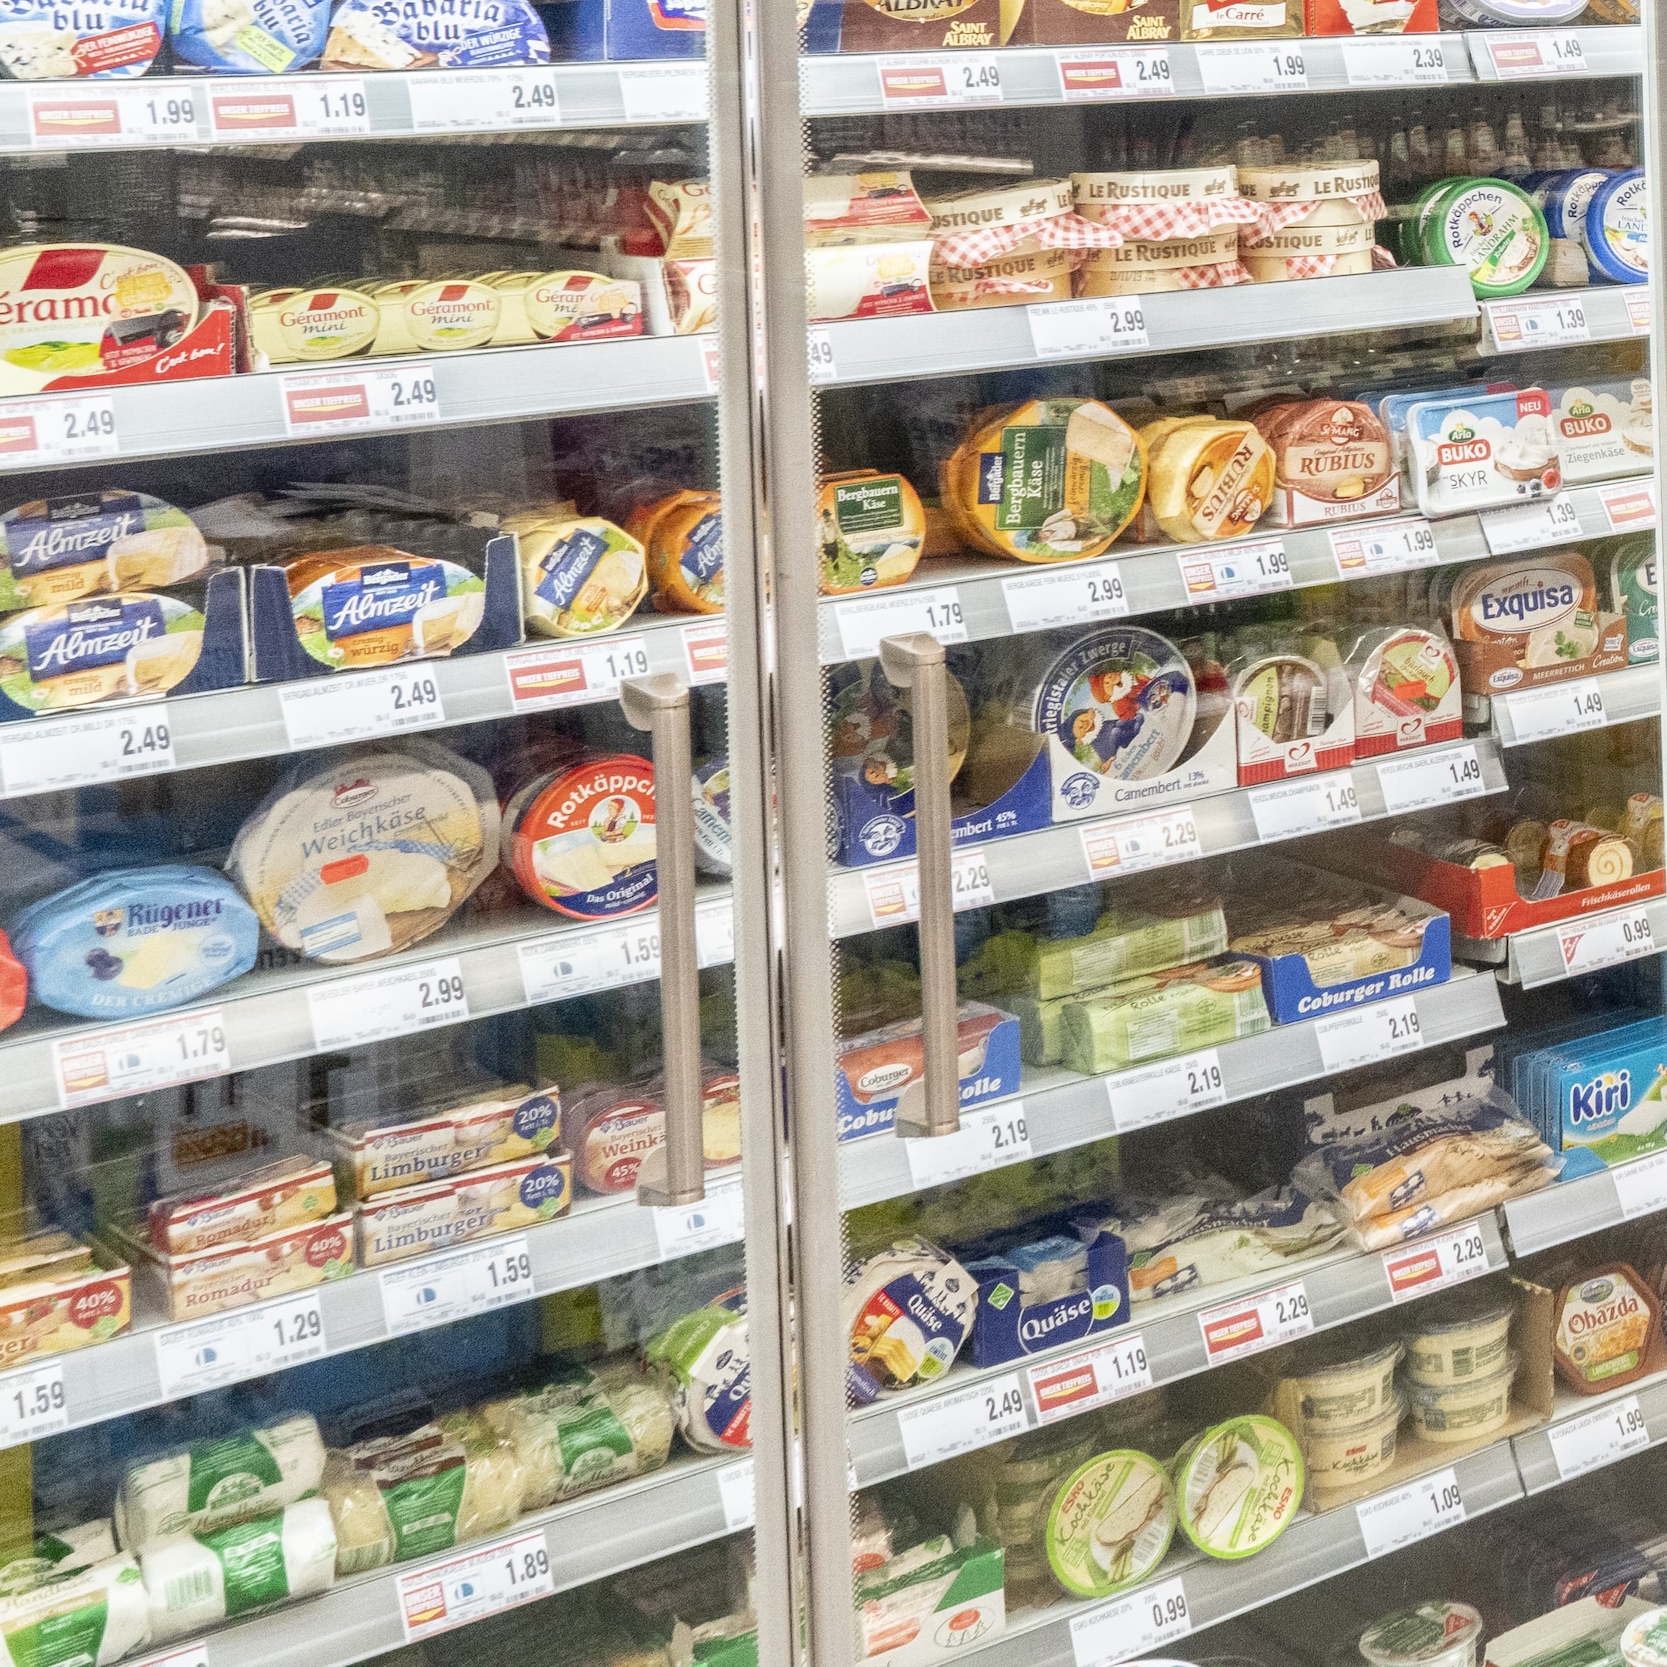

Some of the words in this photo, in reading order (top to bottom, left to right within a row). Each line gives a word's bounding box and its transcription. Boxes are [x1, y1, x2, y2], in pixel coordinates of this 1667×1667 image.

[54, 10, 104, 31] blu
[415, 16, 462, 41] blu
[512, 84, 555, 109] 2.49
[146, 99, 195, 125] 1.99
[1089, 184, 1106, 198] LE
[1107, 181, 1191, 198] RUSTIQUE
[280, 306, 365, 327] Géramont
[411, 300, 495, 316] Géramont
[431, 312, 475, 324] mini
[1110, 311, 1145, 333] 2.99
[302, 320, 347, 334] mini
[391, 380, 437, 406] 2.49
[64, 409, 115, 439] 2.49
[1563, 416, 1608, 435] BUKO
[1441, 443, 1488, 462] BUKO
[1567, 446, 1626, 464] Ziegenkäse
[1005, 432, 1027, 525] Bergbauern
[836, 484, 899, 503] Bergbauern
[14, 513, 138, 567] Almzeit
[553, 536, 597, 606] Almzeit
[1088, 578, 1124, 602] 2.99
[1482, 582, 1575, 621] Exquisa
[32, 616, 158, 671] Almzeit
[606, 650, 648, 678] 1.19
[391, 680, 437, 709] 2.49
[1573, 692, 1602, 716] 1.49
[120, 724, 171, 756] 2.49
[1449, 759, 1480, 784] 1.49
[1114, 778, 1182, 803] Camembert
[955, 865, 990, 892] 2.29
[1581, 881, 1651, 907] Frischkäserollen
[128, 898, 225, 926] Rügener
[419, 976, 465, 1008] 2.99
[1298, 977, 1384, 1014] Coburger
[1388, 966, 1436, 993] Rolle
[1389, 1012, 1420, 1039] 2.19
[177, 1027, 226, 1061] 1.79
[860, 1065, 911, 1088] Coburger
[1188, 1066, 1221, 1095] 2.19
[1571, 1069, 1631, 1123] Kiri
[517, 1105, 552, 1124] 20%
[992, 1118, 1029, 1149] 2.19
[371, 1145, 484, 1183] Limburger
[374, 1214, 488, 1254] Limburger
[1453, 1237, 1484, 1264] 2.29
[487, 1253, 531, 1289] 1.59
[75, 1288, 116, 1312] 40%
[186, 1274, 274, 1308] Romadur
[274, 1310, 322, 1345] 1.29
[1021, 1297, 1091, 1339] Quäse
[1113, 1348, 1147, 1378] 1.19
[986, 1389, 1023, 1421] 2.49
[1615, 1408, 1645, 1438] 1.99
[1430, 1484, 1462, 1514] 1.09
[505, 1548, 549, 1585] 1.89
[1152, 1594, 1187, 1628] 0.99
